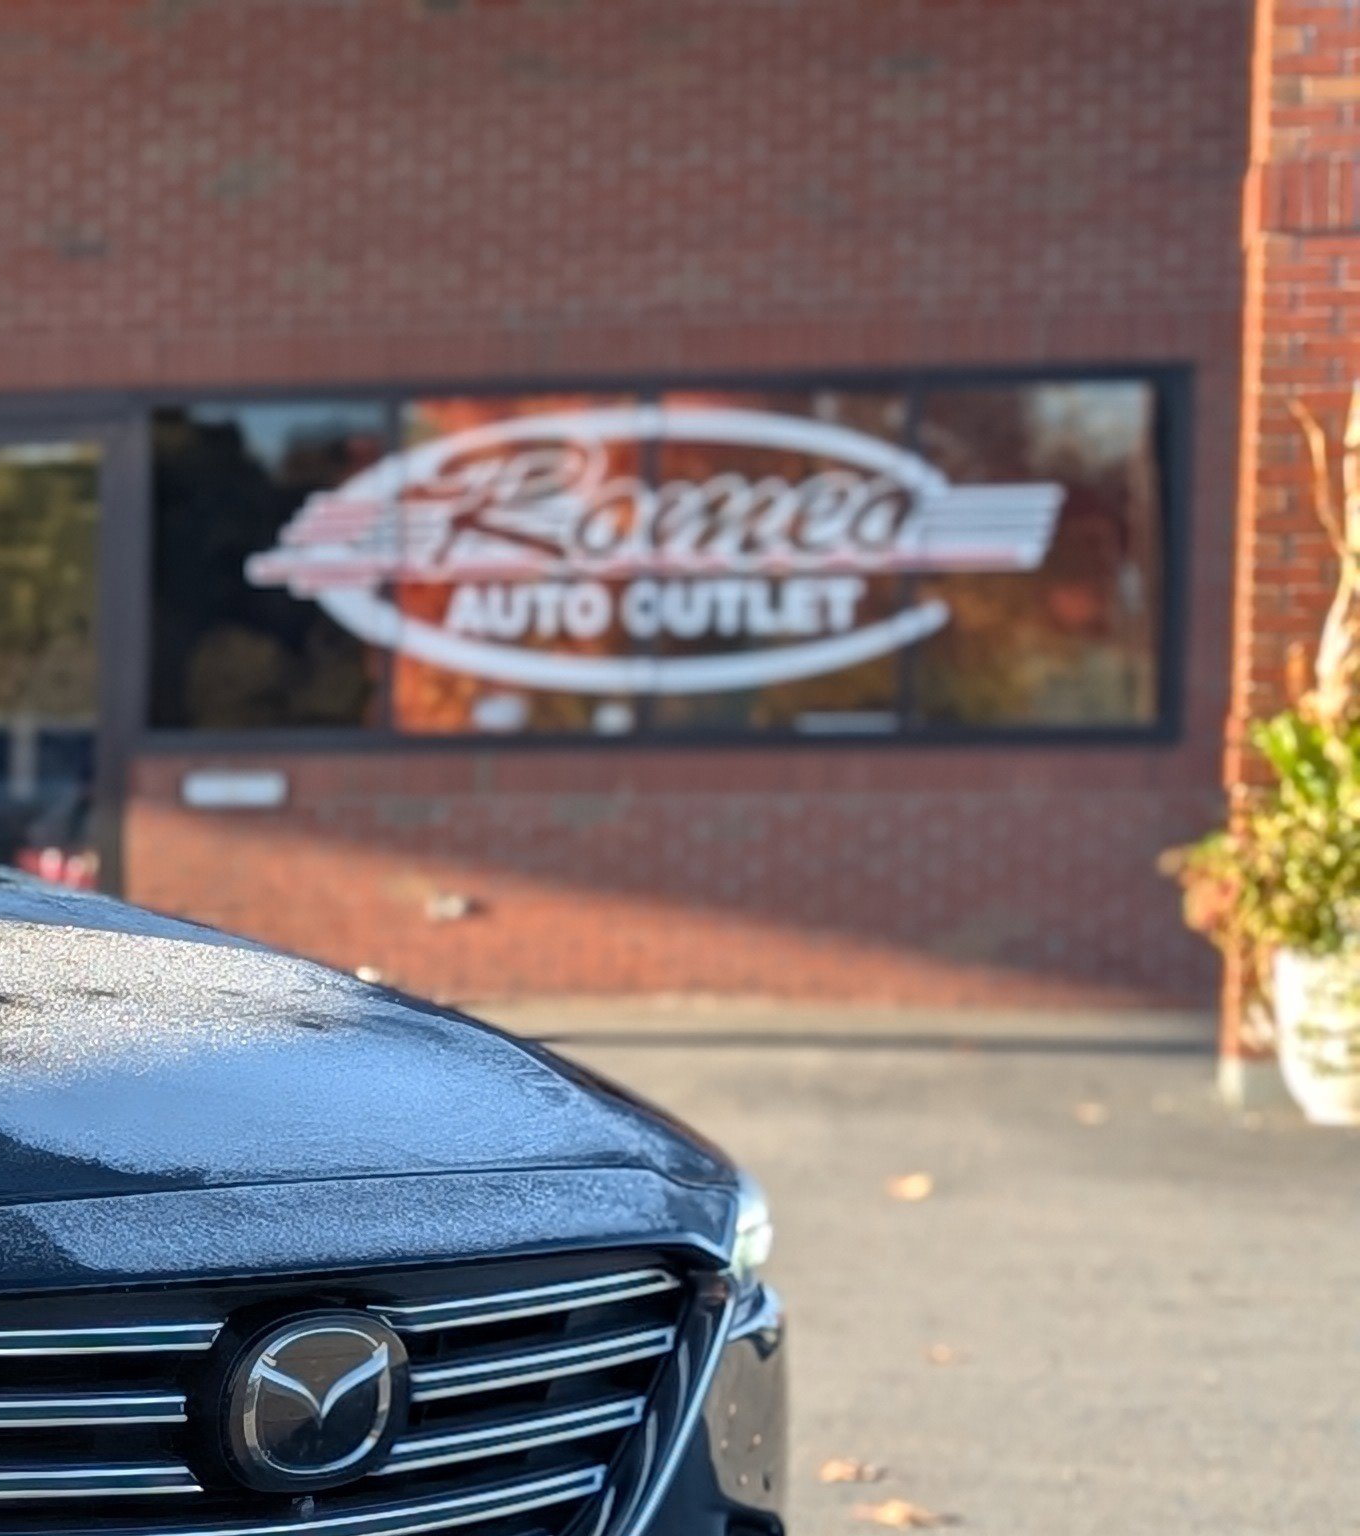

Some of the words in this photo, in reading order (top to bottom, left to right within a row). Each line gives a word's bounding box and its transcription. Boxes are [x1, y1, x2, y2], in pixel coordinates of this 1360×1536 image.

[422, 433, 922, 566] Romeo
[443, 578, 612, 638] AUTO
[620, 576, 865, 638] OUTLET
